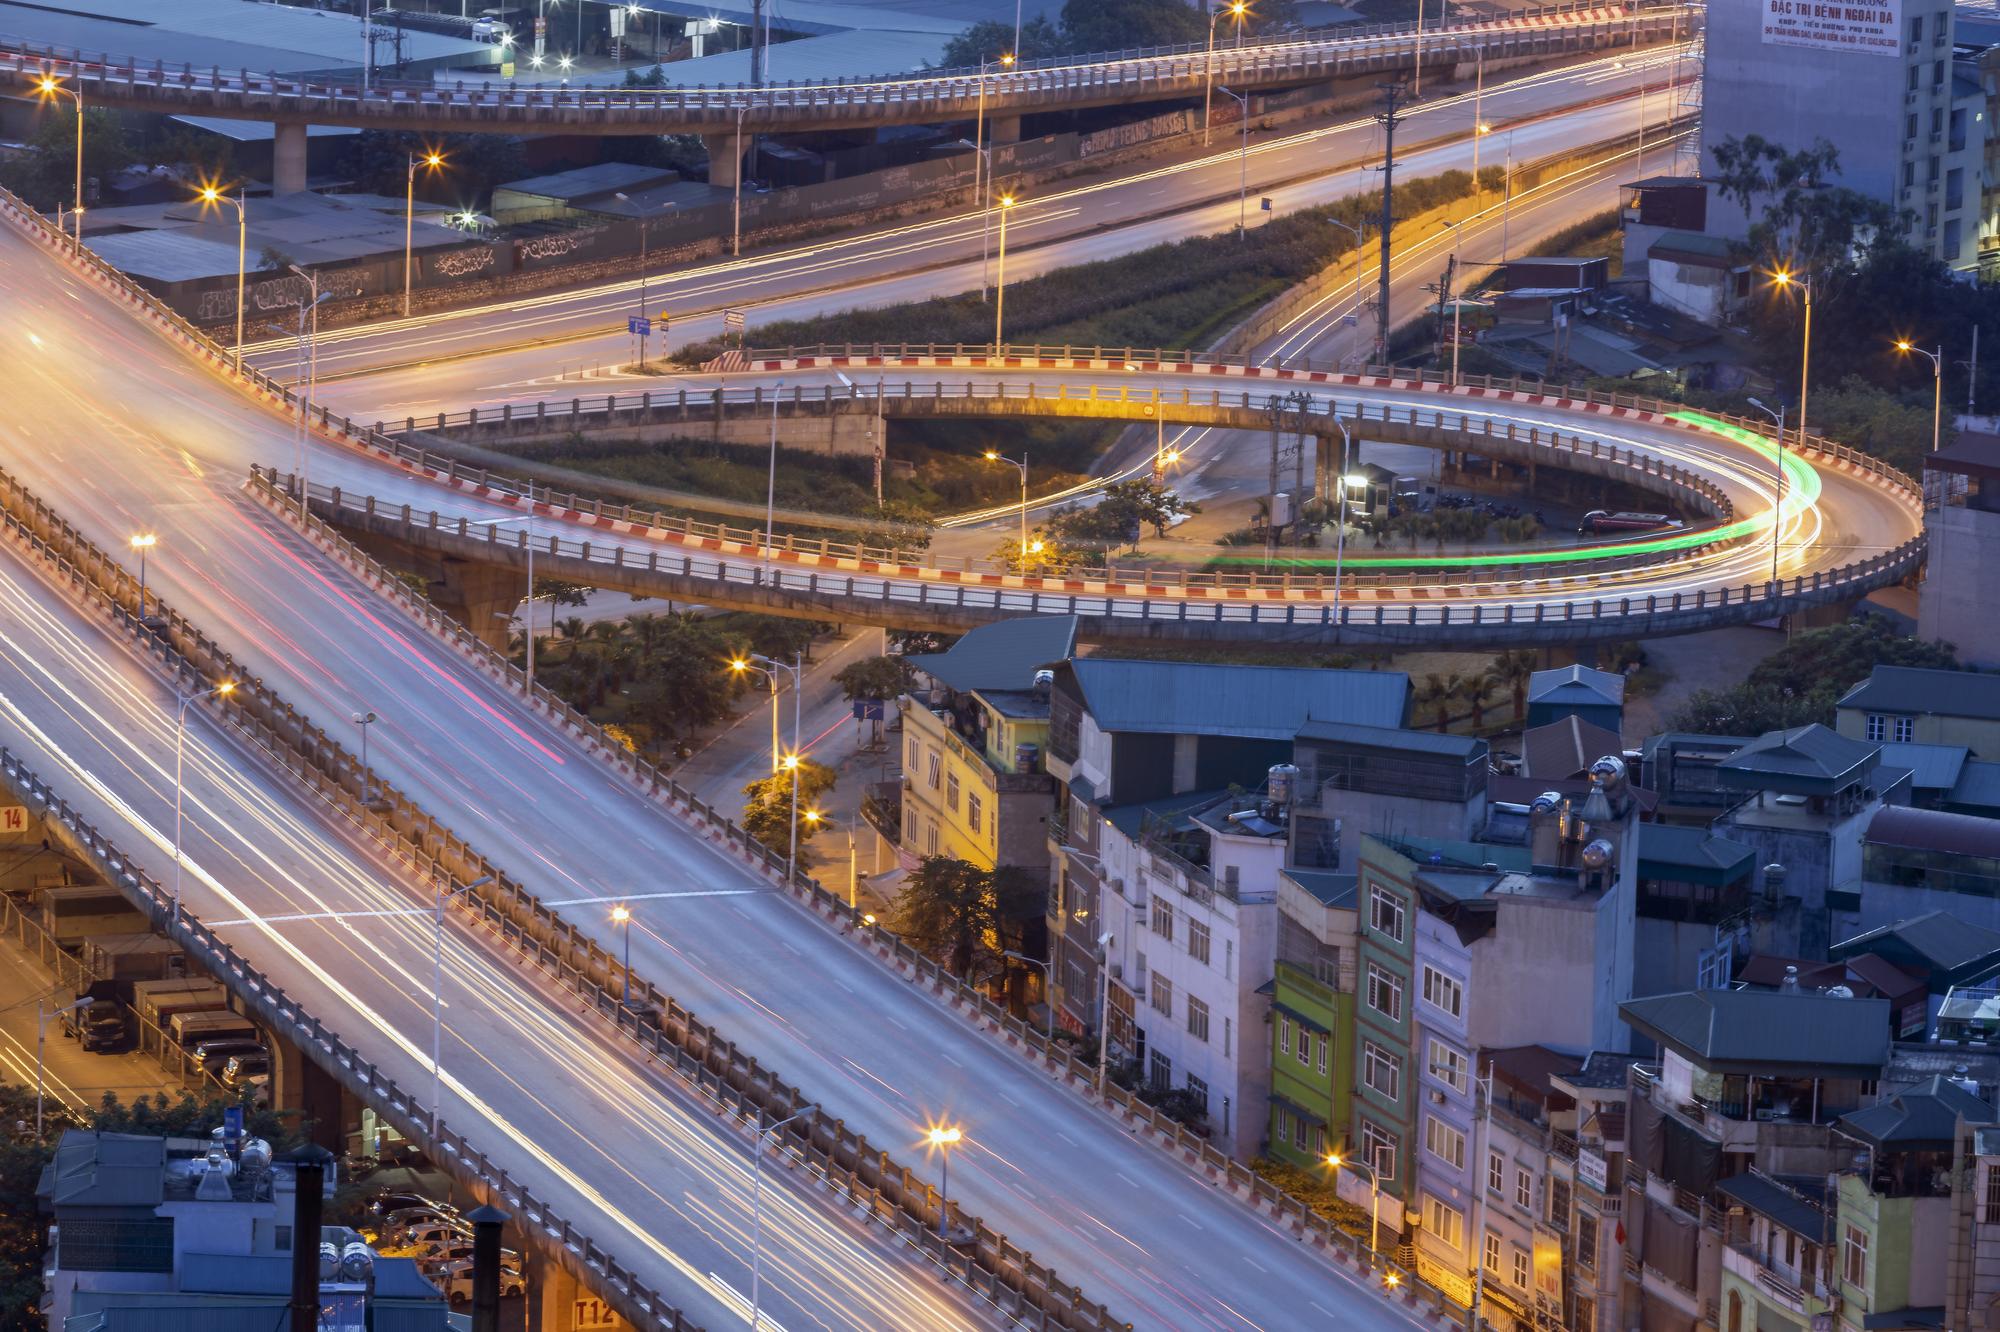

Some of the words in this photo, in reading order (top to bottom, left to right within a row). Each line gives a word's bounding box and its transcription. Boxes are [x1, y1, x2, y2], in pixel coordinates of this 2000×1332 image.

[1796, 3, 1811, 18] TRỊ
[1815, 4, 1842, 20] BỆNH
[1845, 8, 1876, 22] NGOÀI
[1879, 11, 1893, 24] DA
[4, 808, 21, 829] 14
[575, 1301, 614, 1325] T12
